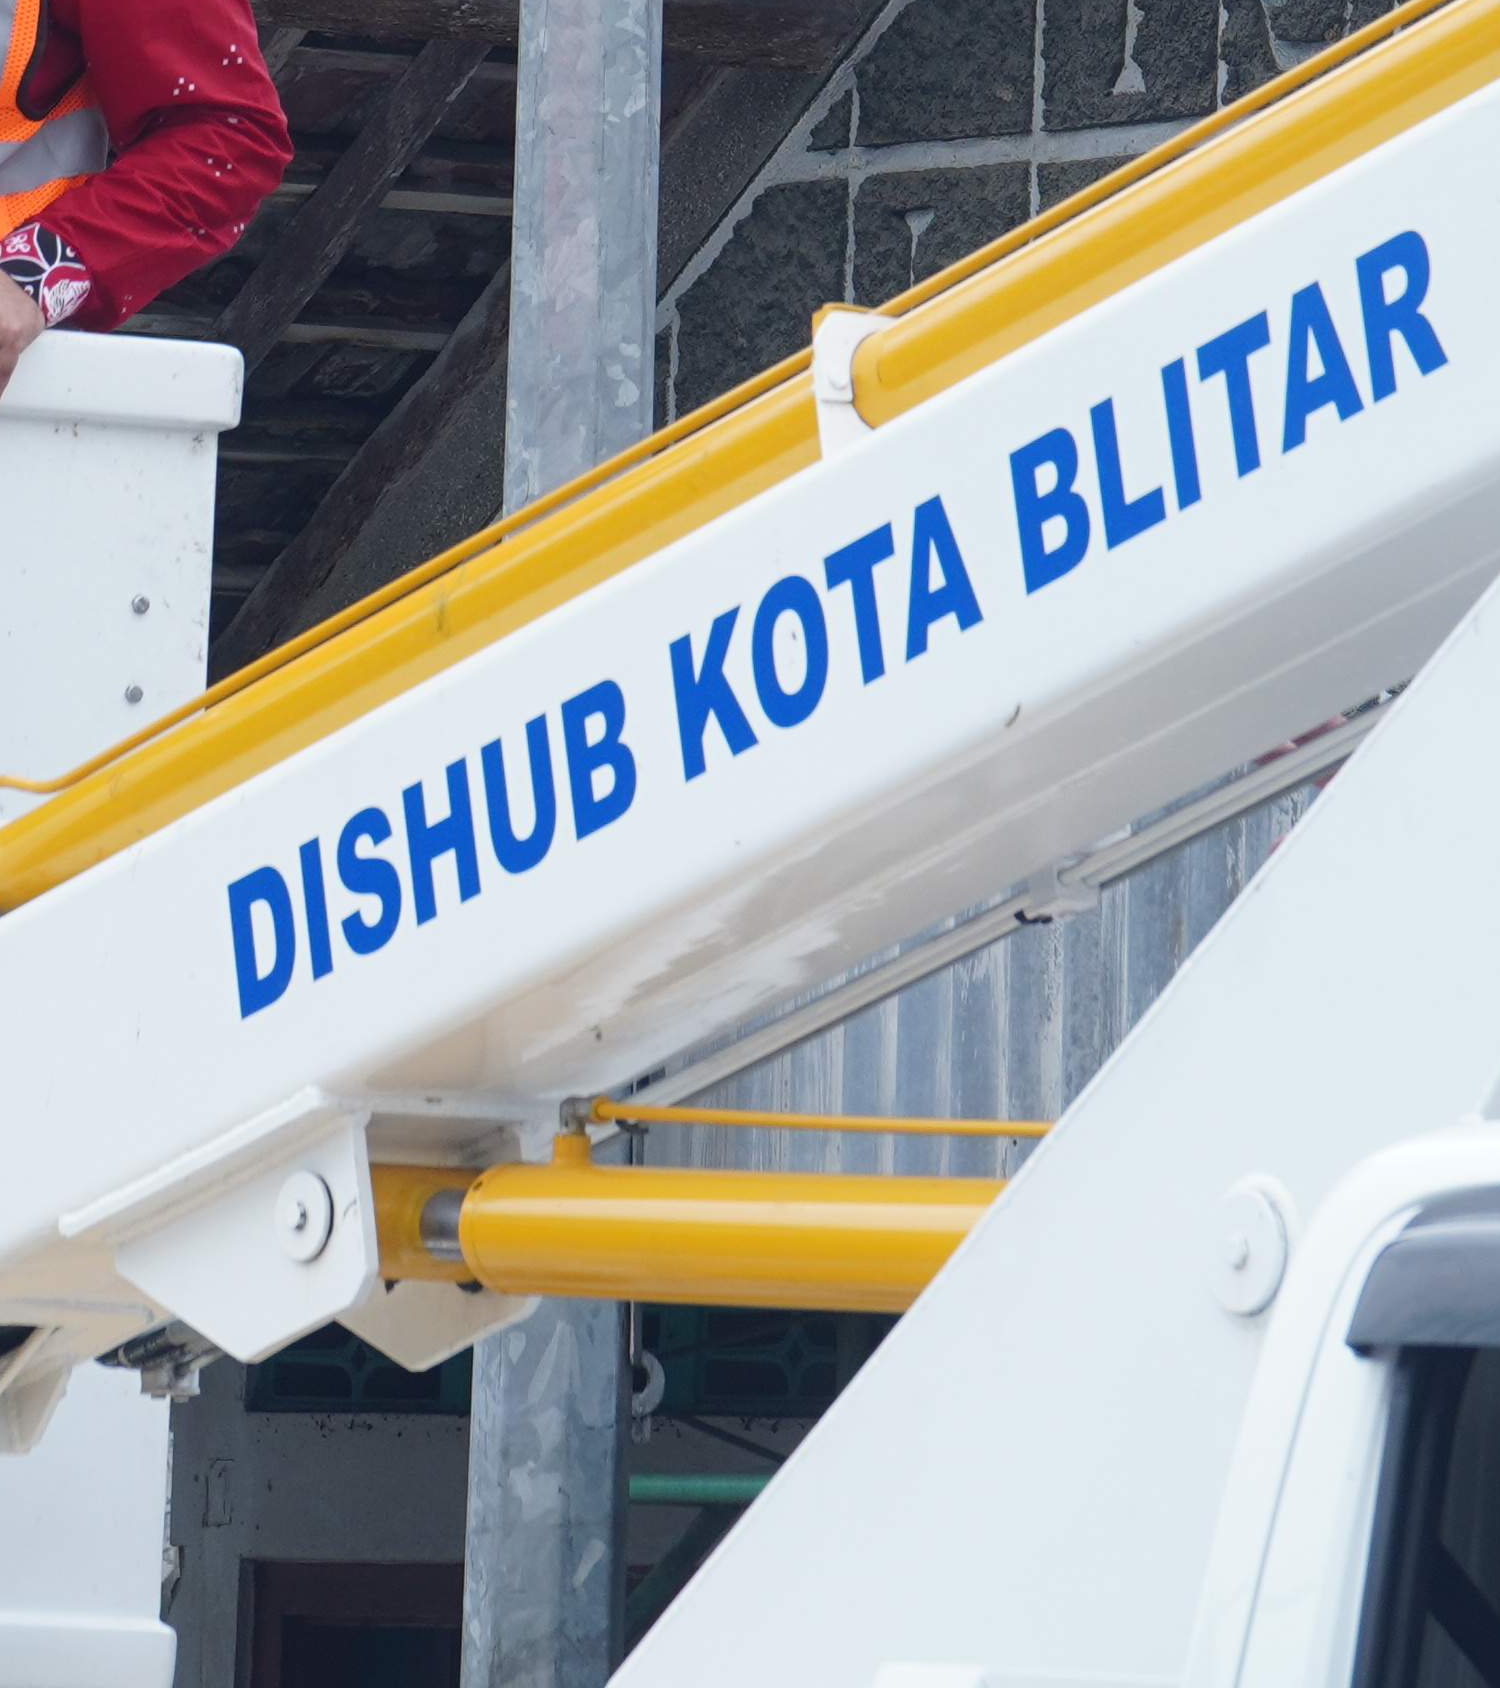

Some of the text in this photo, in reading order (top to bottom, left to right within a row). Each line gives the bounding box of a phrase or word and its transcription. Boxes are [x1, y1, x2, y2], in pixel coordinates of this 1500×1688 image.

[228, 230, 1449, 1020] DISHUB KOTA BLITAR
